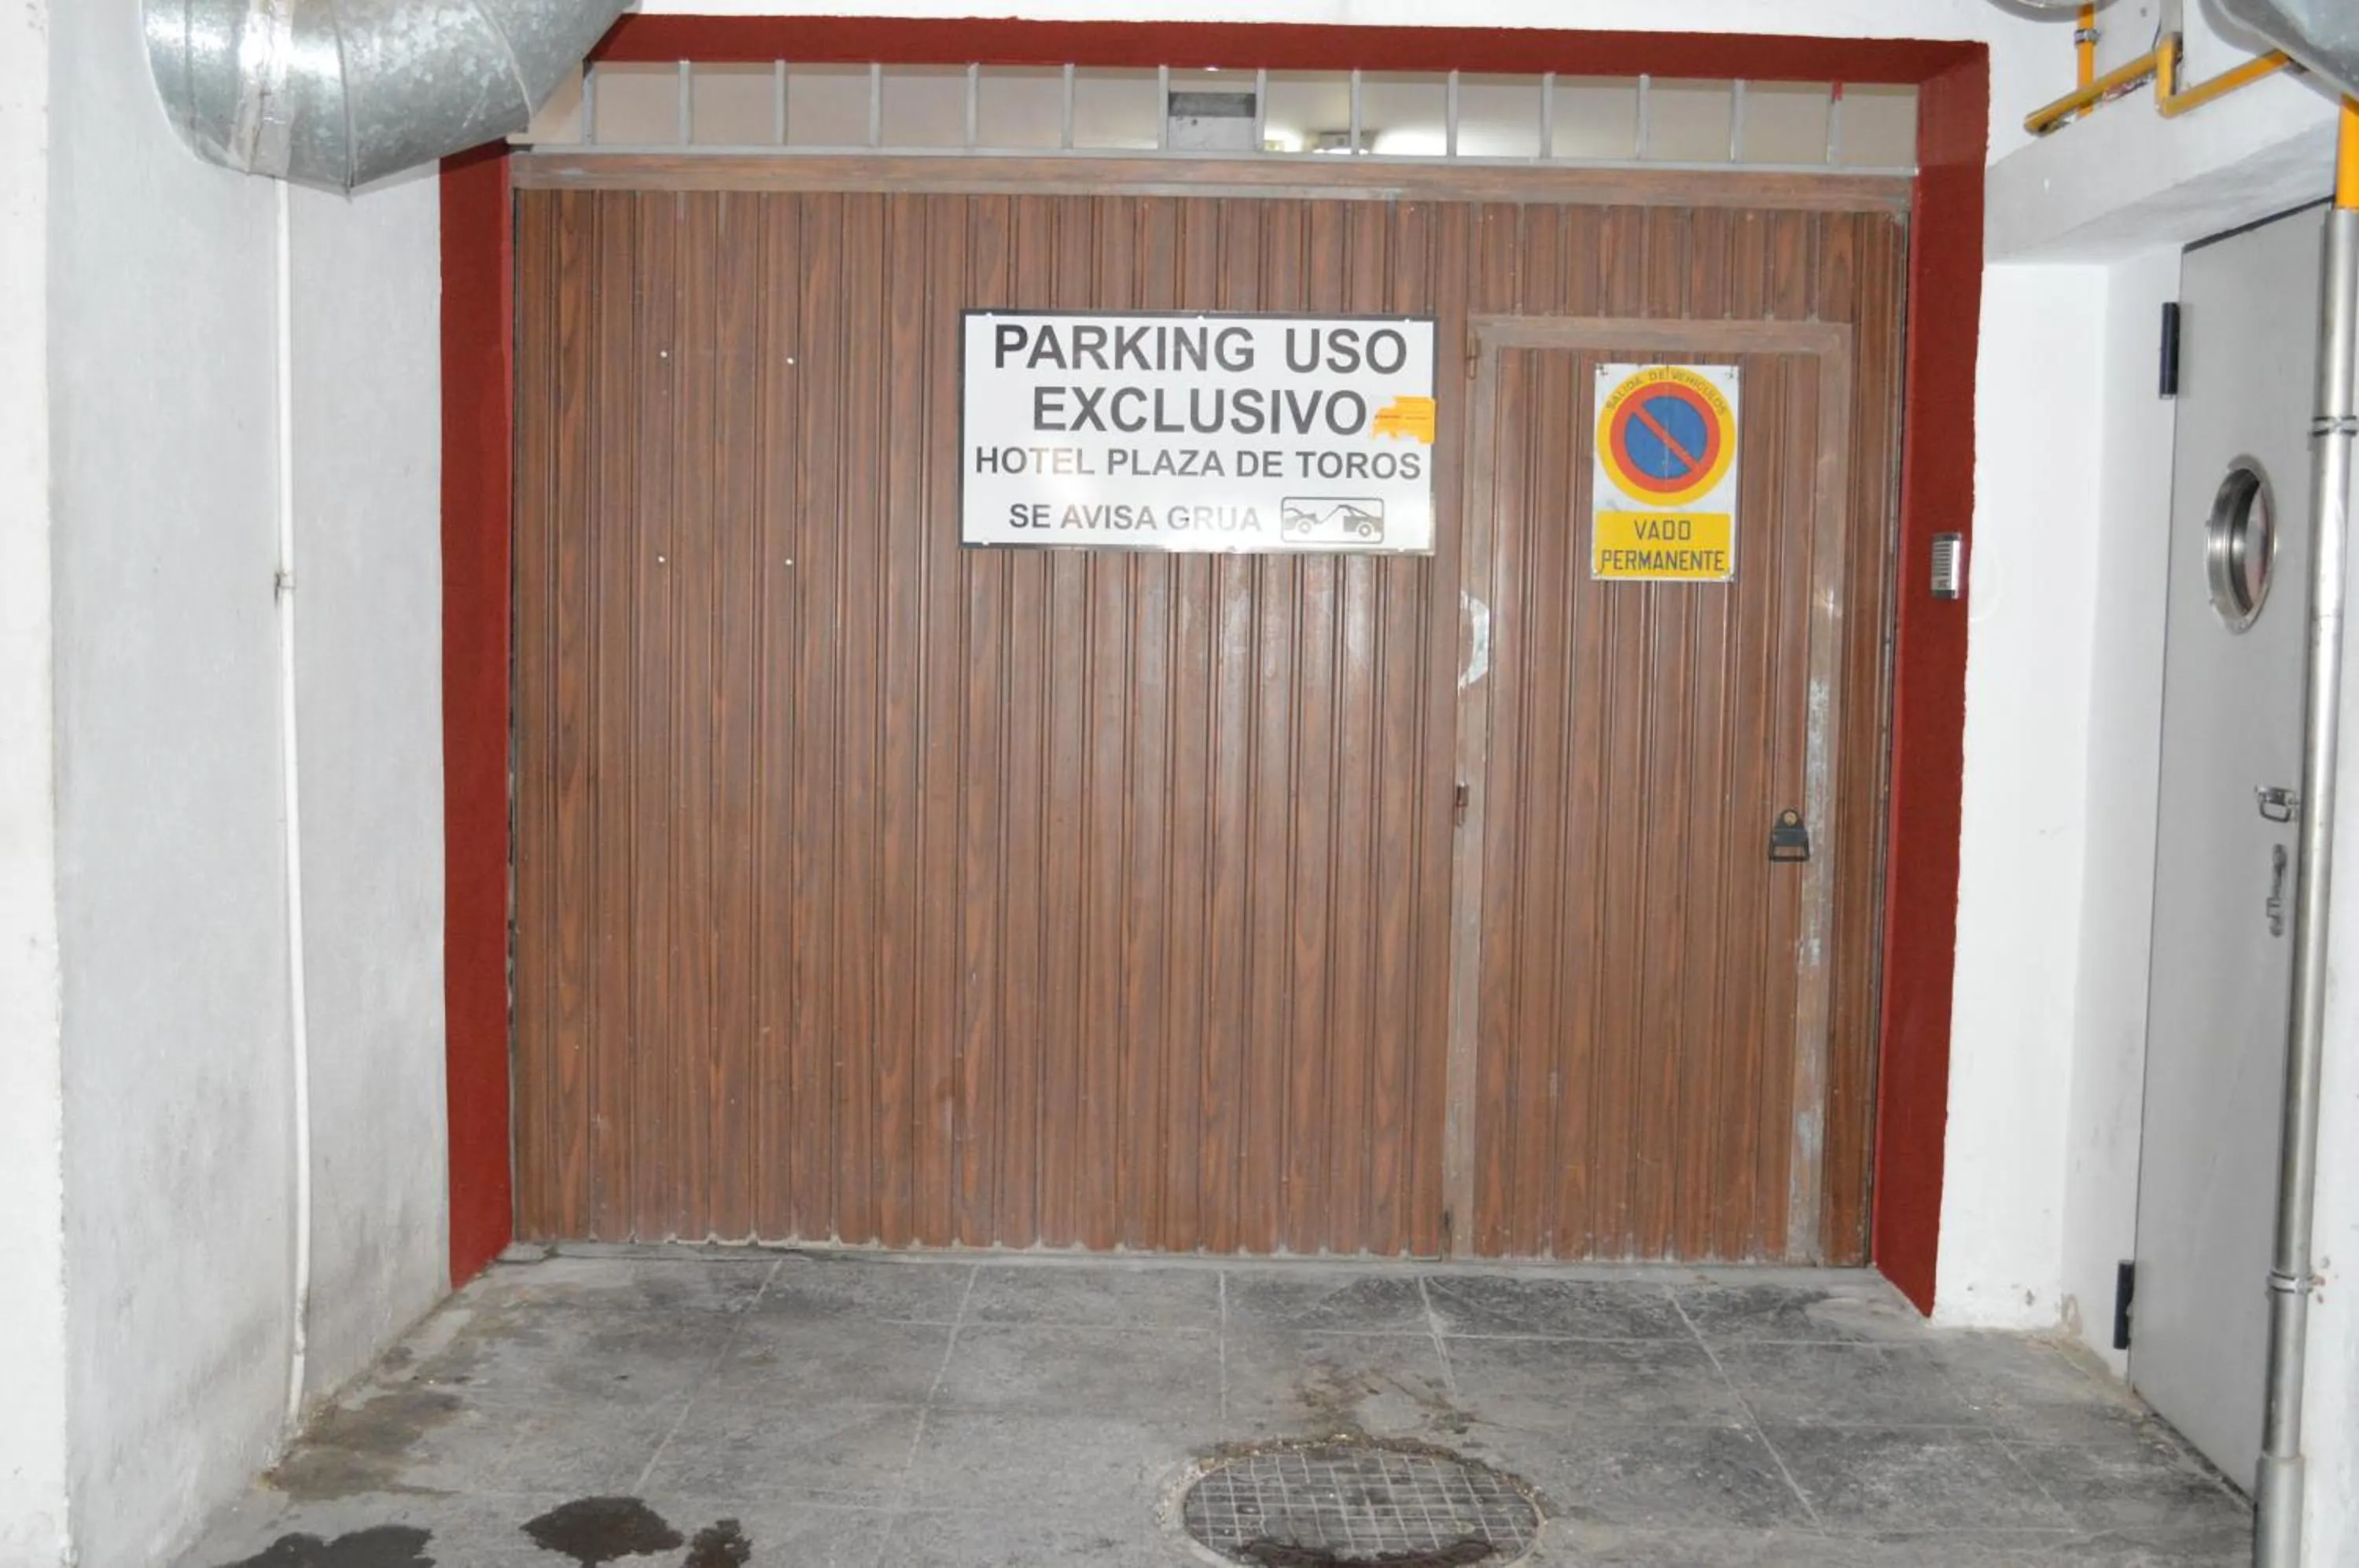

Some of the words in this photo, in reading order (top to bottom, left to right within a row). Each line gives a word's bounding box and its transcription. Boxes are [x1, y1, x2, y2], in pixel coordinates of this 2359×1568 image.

[995, 324, 1255, 372] PARKING
[1286, 328, 1408, 374] USO
[1033, 386, 1367, 435] EXCLUSIVO
[975, 446, 1095, 475] HOTEL
[1107, 450, 1225, 477] PLAZA
[1236, 451, 1283, 477] DE
[1295, 451, 1422, 480] TOROS
[1009, 503, 1051, 529] SE
[1060, 504, 1157, 530] AVISA
[1167, 506, 1262, 532] GRUA
[1634, 520, 1691, 540] VADO
[1601, 550, 1725, 571] PERMANENTE
